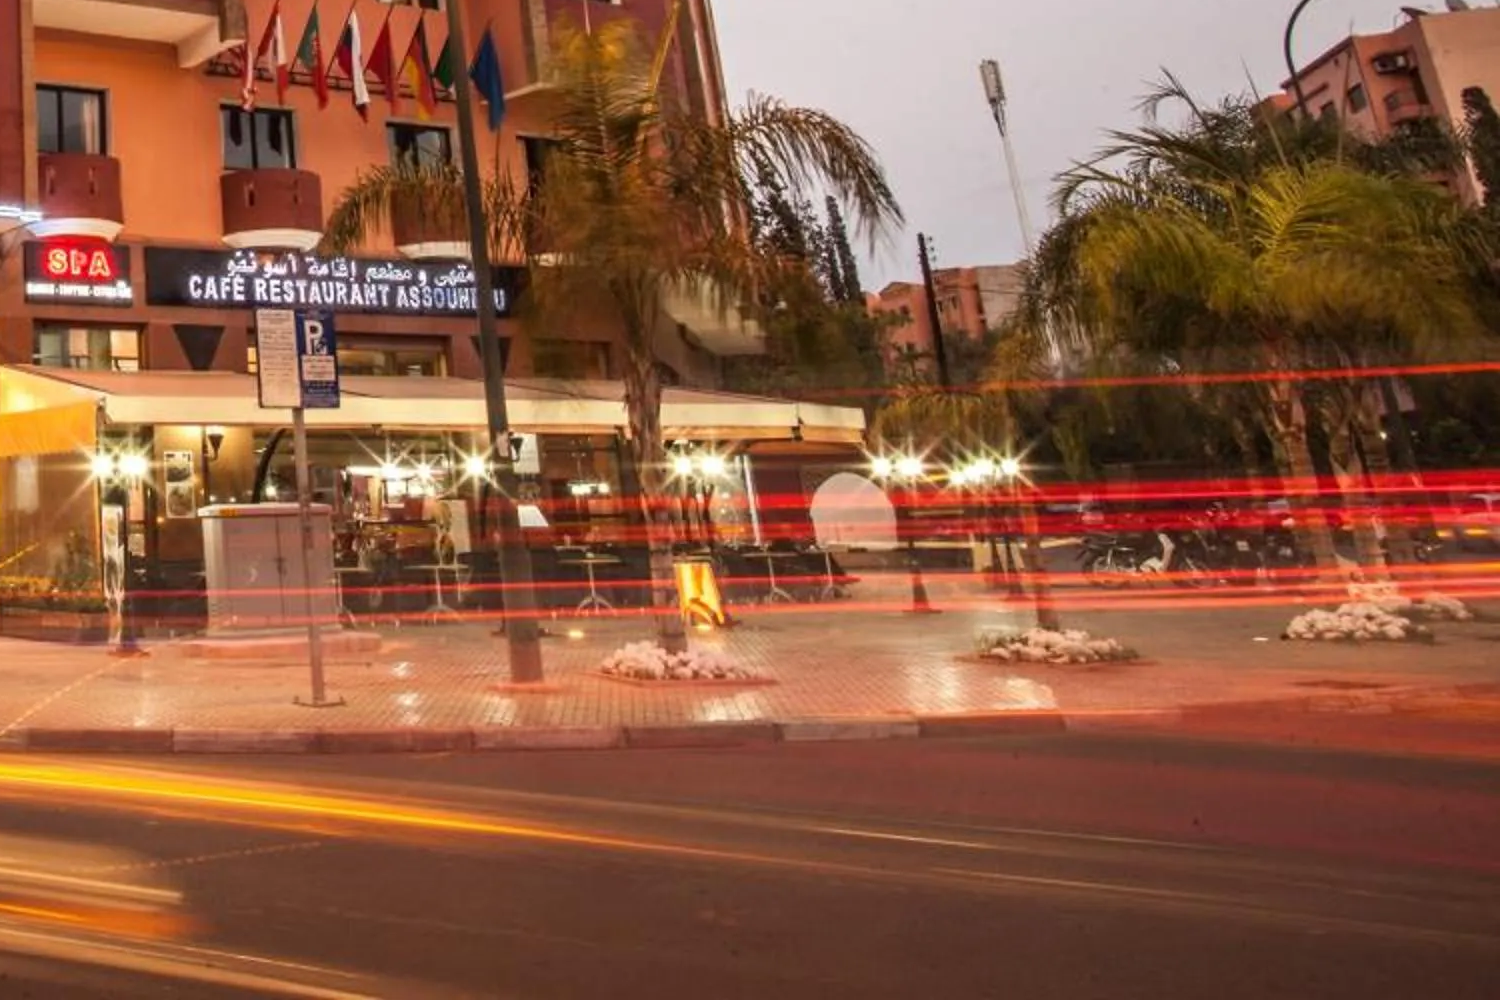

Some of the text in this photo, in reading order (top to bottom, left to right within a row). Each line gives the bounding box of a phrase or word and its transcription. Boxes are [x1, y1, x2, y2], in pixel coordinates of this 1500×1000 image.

[48, 248, 111, 277] SPA
[188, 273, 246, 301] CAFÉ
[254, 277, 391, 308] RESTAURANT
[304, 320, 324, 355] P
